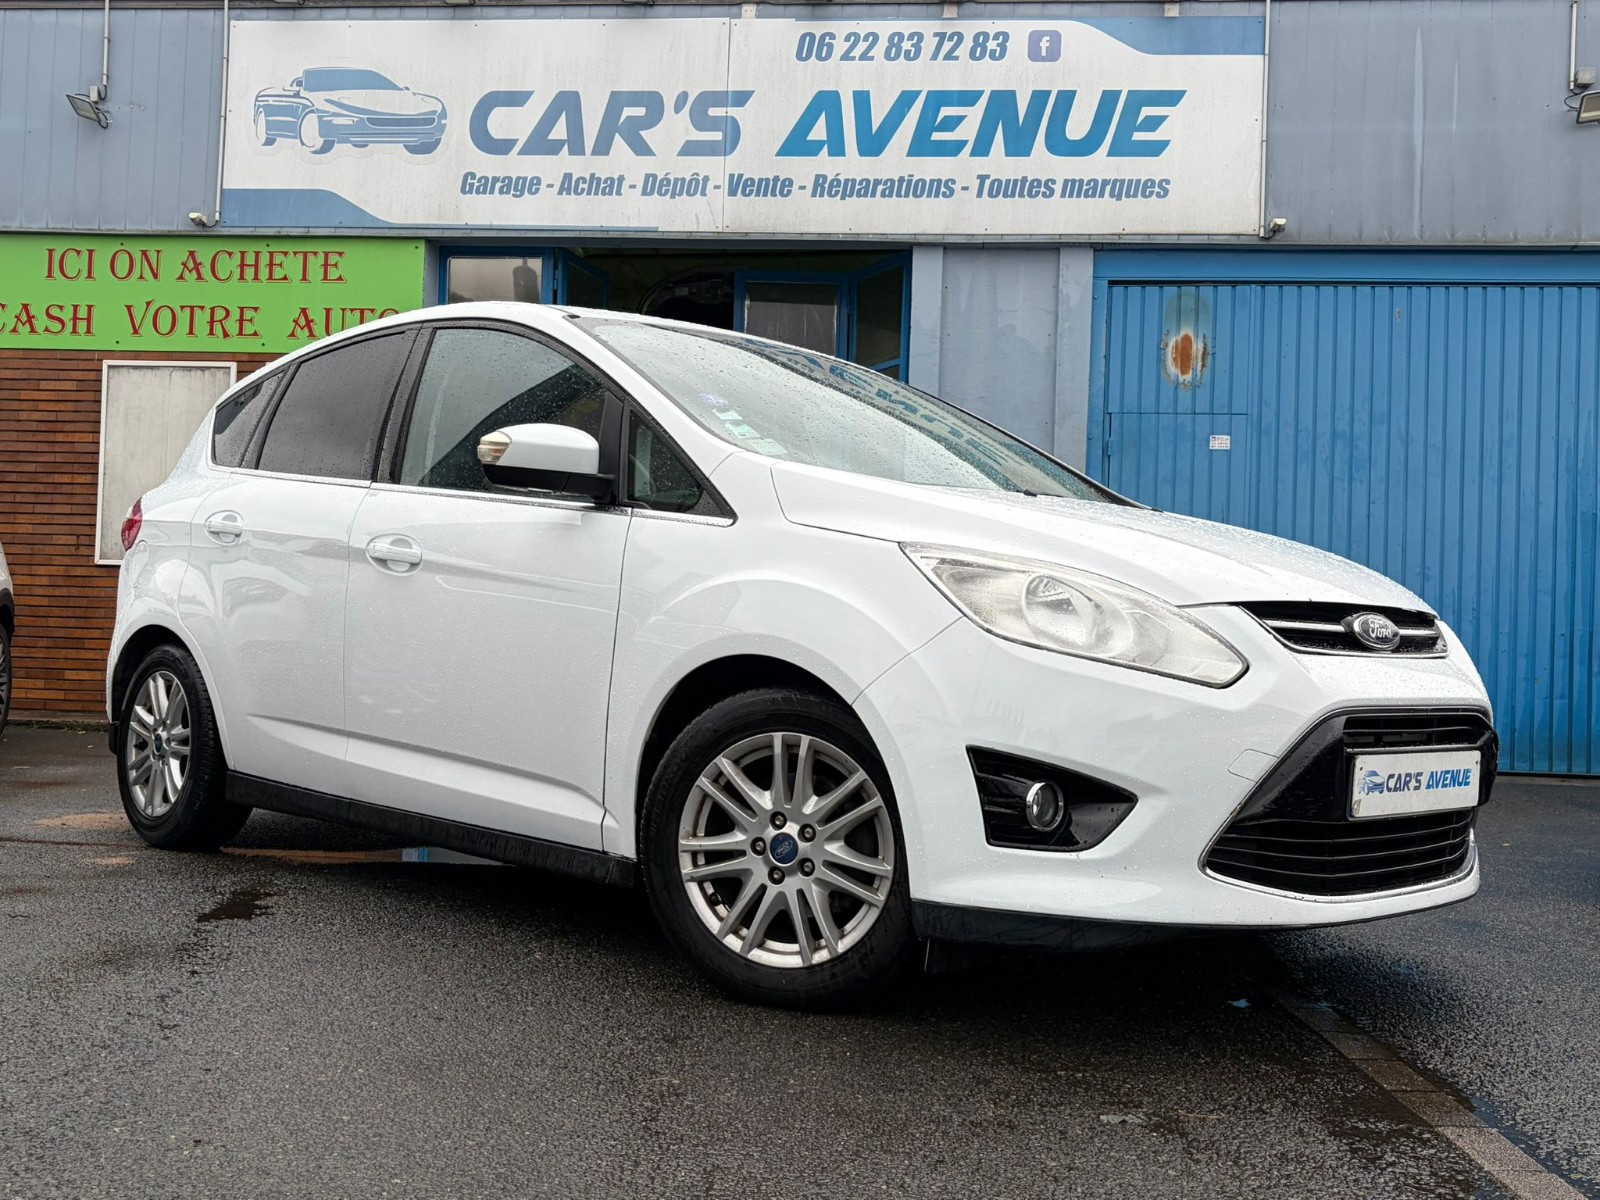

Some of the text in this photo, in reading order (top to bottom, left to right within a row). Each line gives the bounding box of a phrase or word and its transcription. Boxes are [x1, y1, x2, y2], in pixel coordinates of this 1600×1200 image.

[796, 31, 1010, 62] 06 22 83 72 83
[469, 89, 1188, 158] CAR'S AVENUE
[460, 171, 541, 198] Garage
[558, 172, 625, 197] Achat
[641, 172, 710, 200] Dépôt
[727, 174, 793, 199] Vente
[811, 173, 956, 201] Réparations
[975, 174, 1057, 200] Toutes
[1060, 178, 1171, 202] marques
[45, 248, 347, 283] ICI ON ACHETE
[124, 298, 262, 340] VOTRE
[286, 307, 400, 339] AUT
[1368, 619, 1393, 638] Ford
[1385, 768, 1473, 793] CAR'S AVENUE
